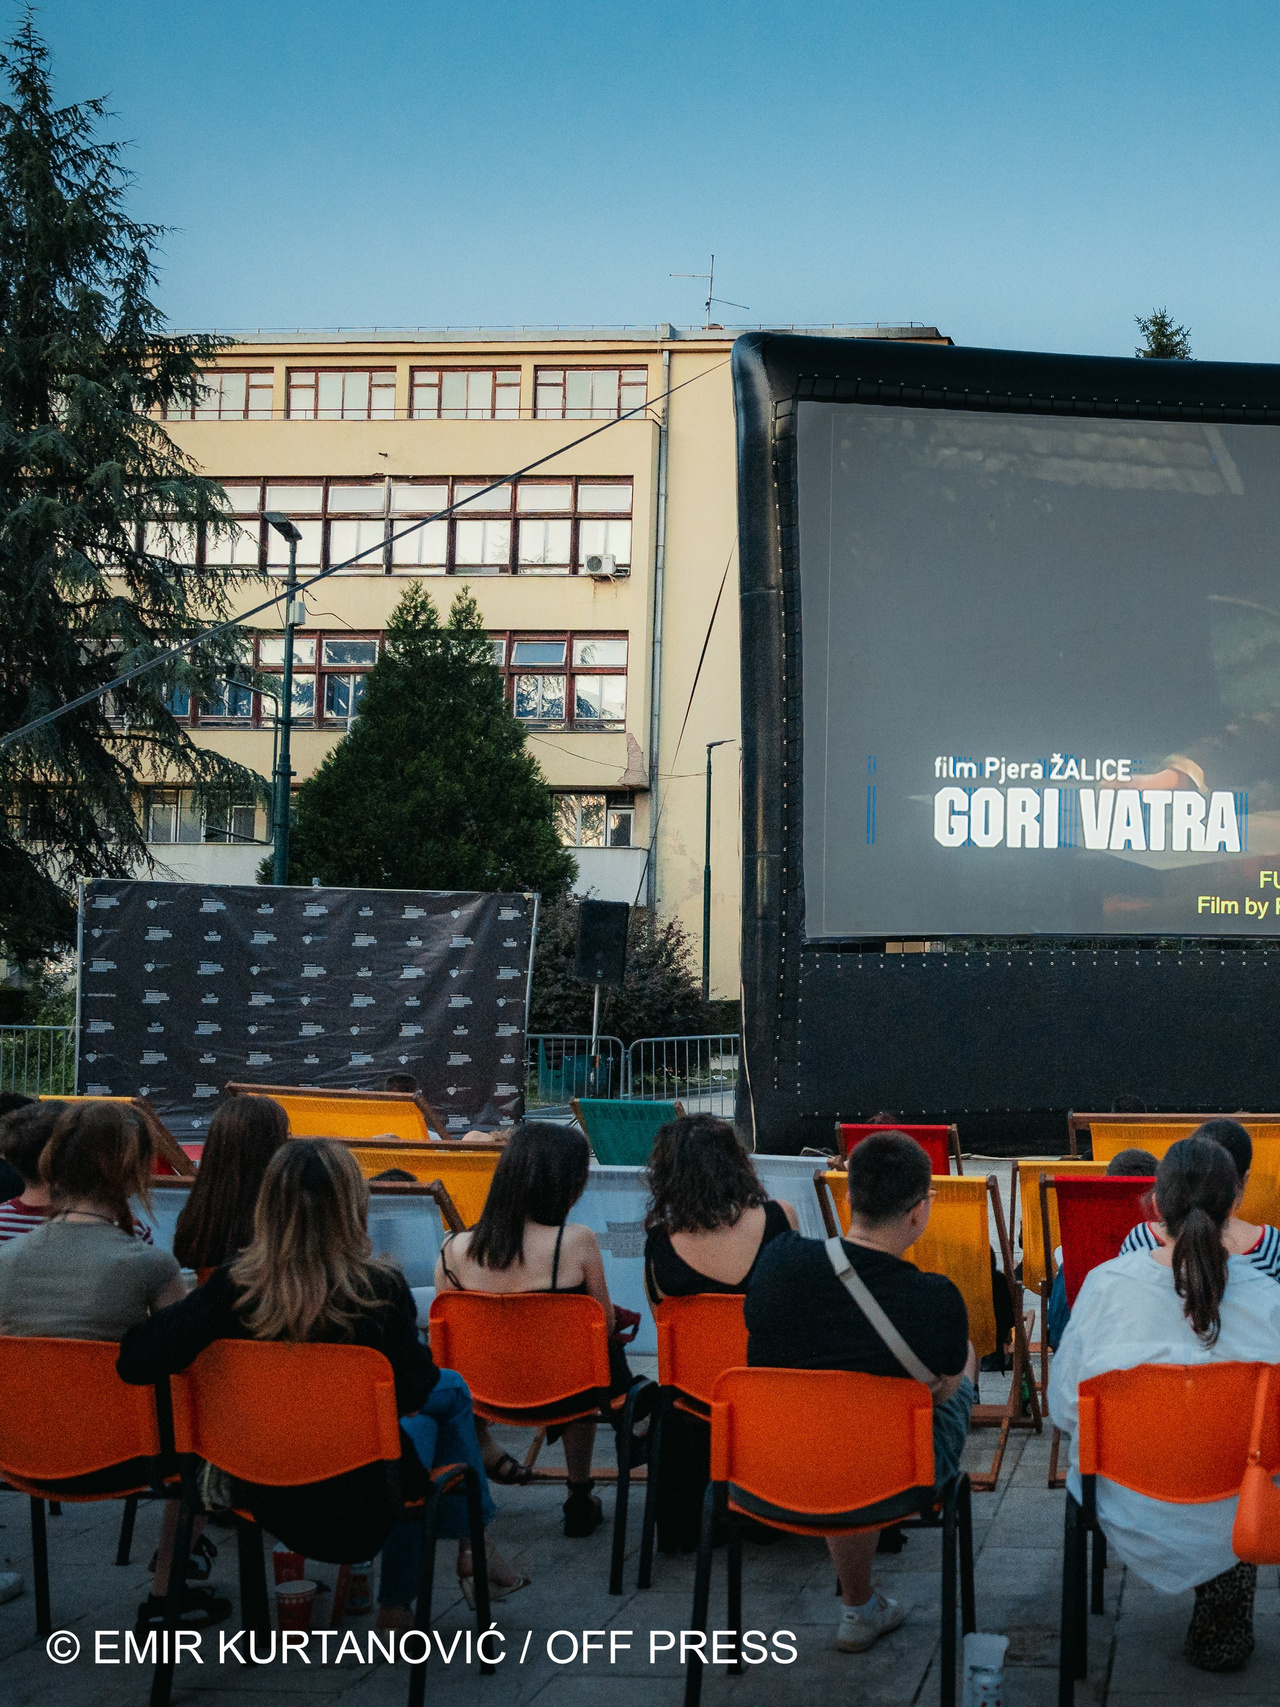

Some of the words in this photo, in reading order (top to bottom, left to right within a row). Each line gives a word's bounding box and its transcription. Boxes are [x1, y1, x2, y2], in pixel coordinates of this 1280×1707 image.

[933, 756, 978, 780] film
[983, 756, 1044, 785] Pjera
[1049, 752, 1133, 782] ŽALICE
[932, 786, 1061, 849] GORI
[1077, 788, 1242, 854] VATRA
[1196, 895, 1240, 915] Film
[1244, 897, 1270, 920] by
